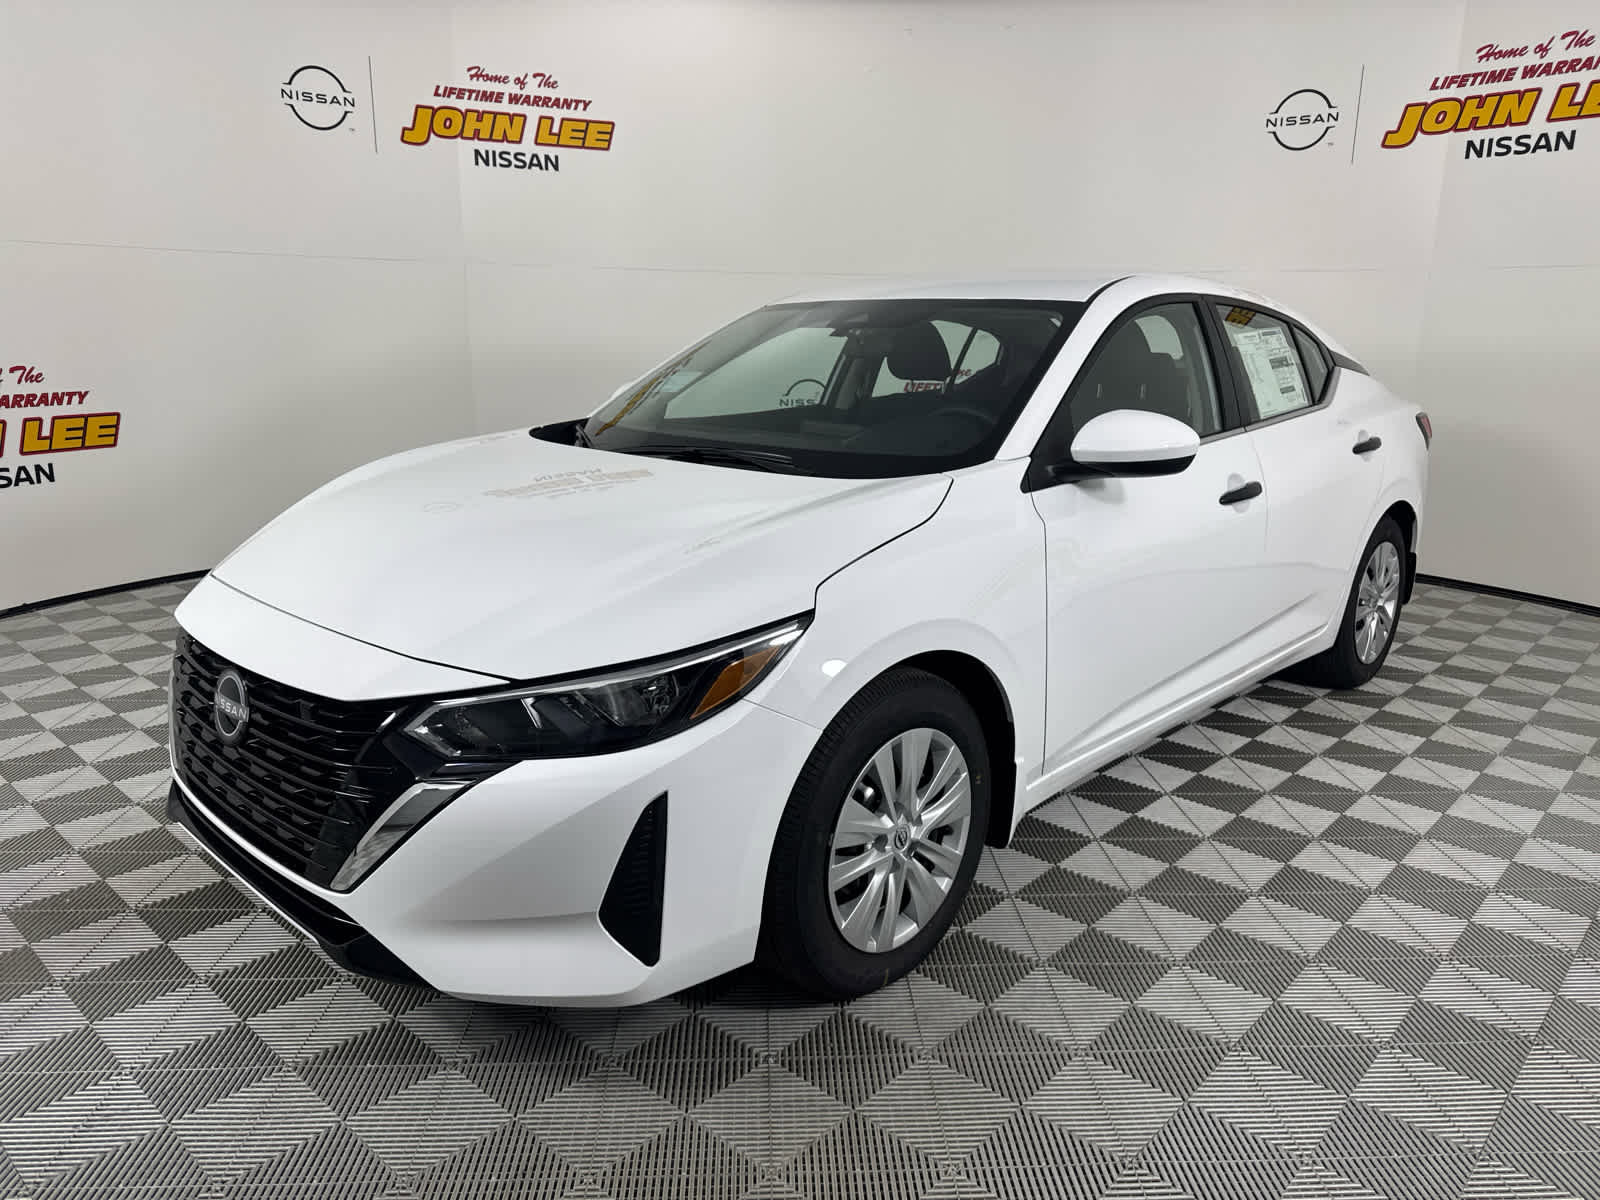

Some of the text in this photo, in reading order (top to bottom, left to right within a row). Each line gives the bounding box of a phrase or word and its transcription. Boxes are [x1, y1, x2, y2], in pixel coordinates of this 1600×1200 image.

[1476, 29, 1596, 63] Home of The
[466, 65, 559, 90] Home of The
[1429, 66, 1518, 91] LIFETIME
[280, 87, 356, 108] NISSAN
[433, 85, 593, 112] LIFETIME WARRANTY
[400, 104, 615, 150] JOHN LEE
[1265, 111, 1340, 129] NISSAN
[1381, 88, 1543, 150] JOHN
[1464, 129, 1577, 160] NISSAN
[473, 149, 560, 171] NISSAN
[9, 365, 45, 385] The
[19, 412, 121, 456] LEE
